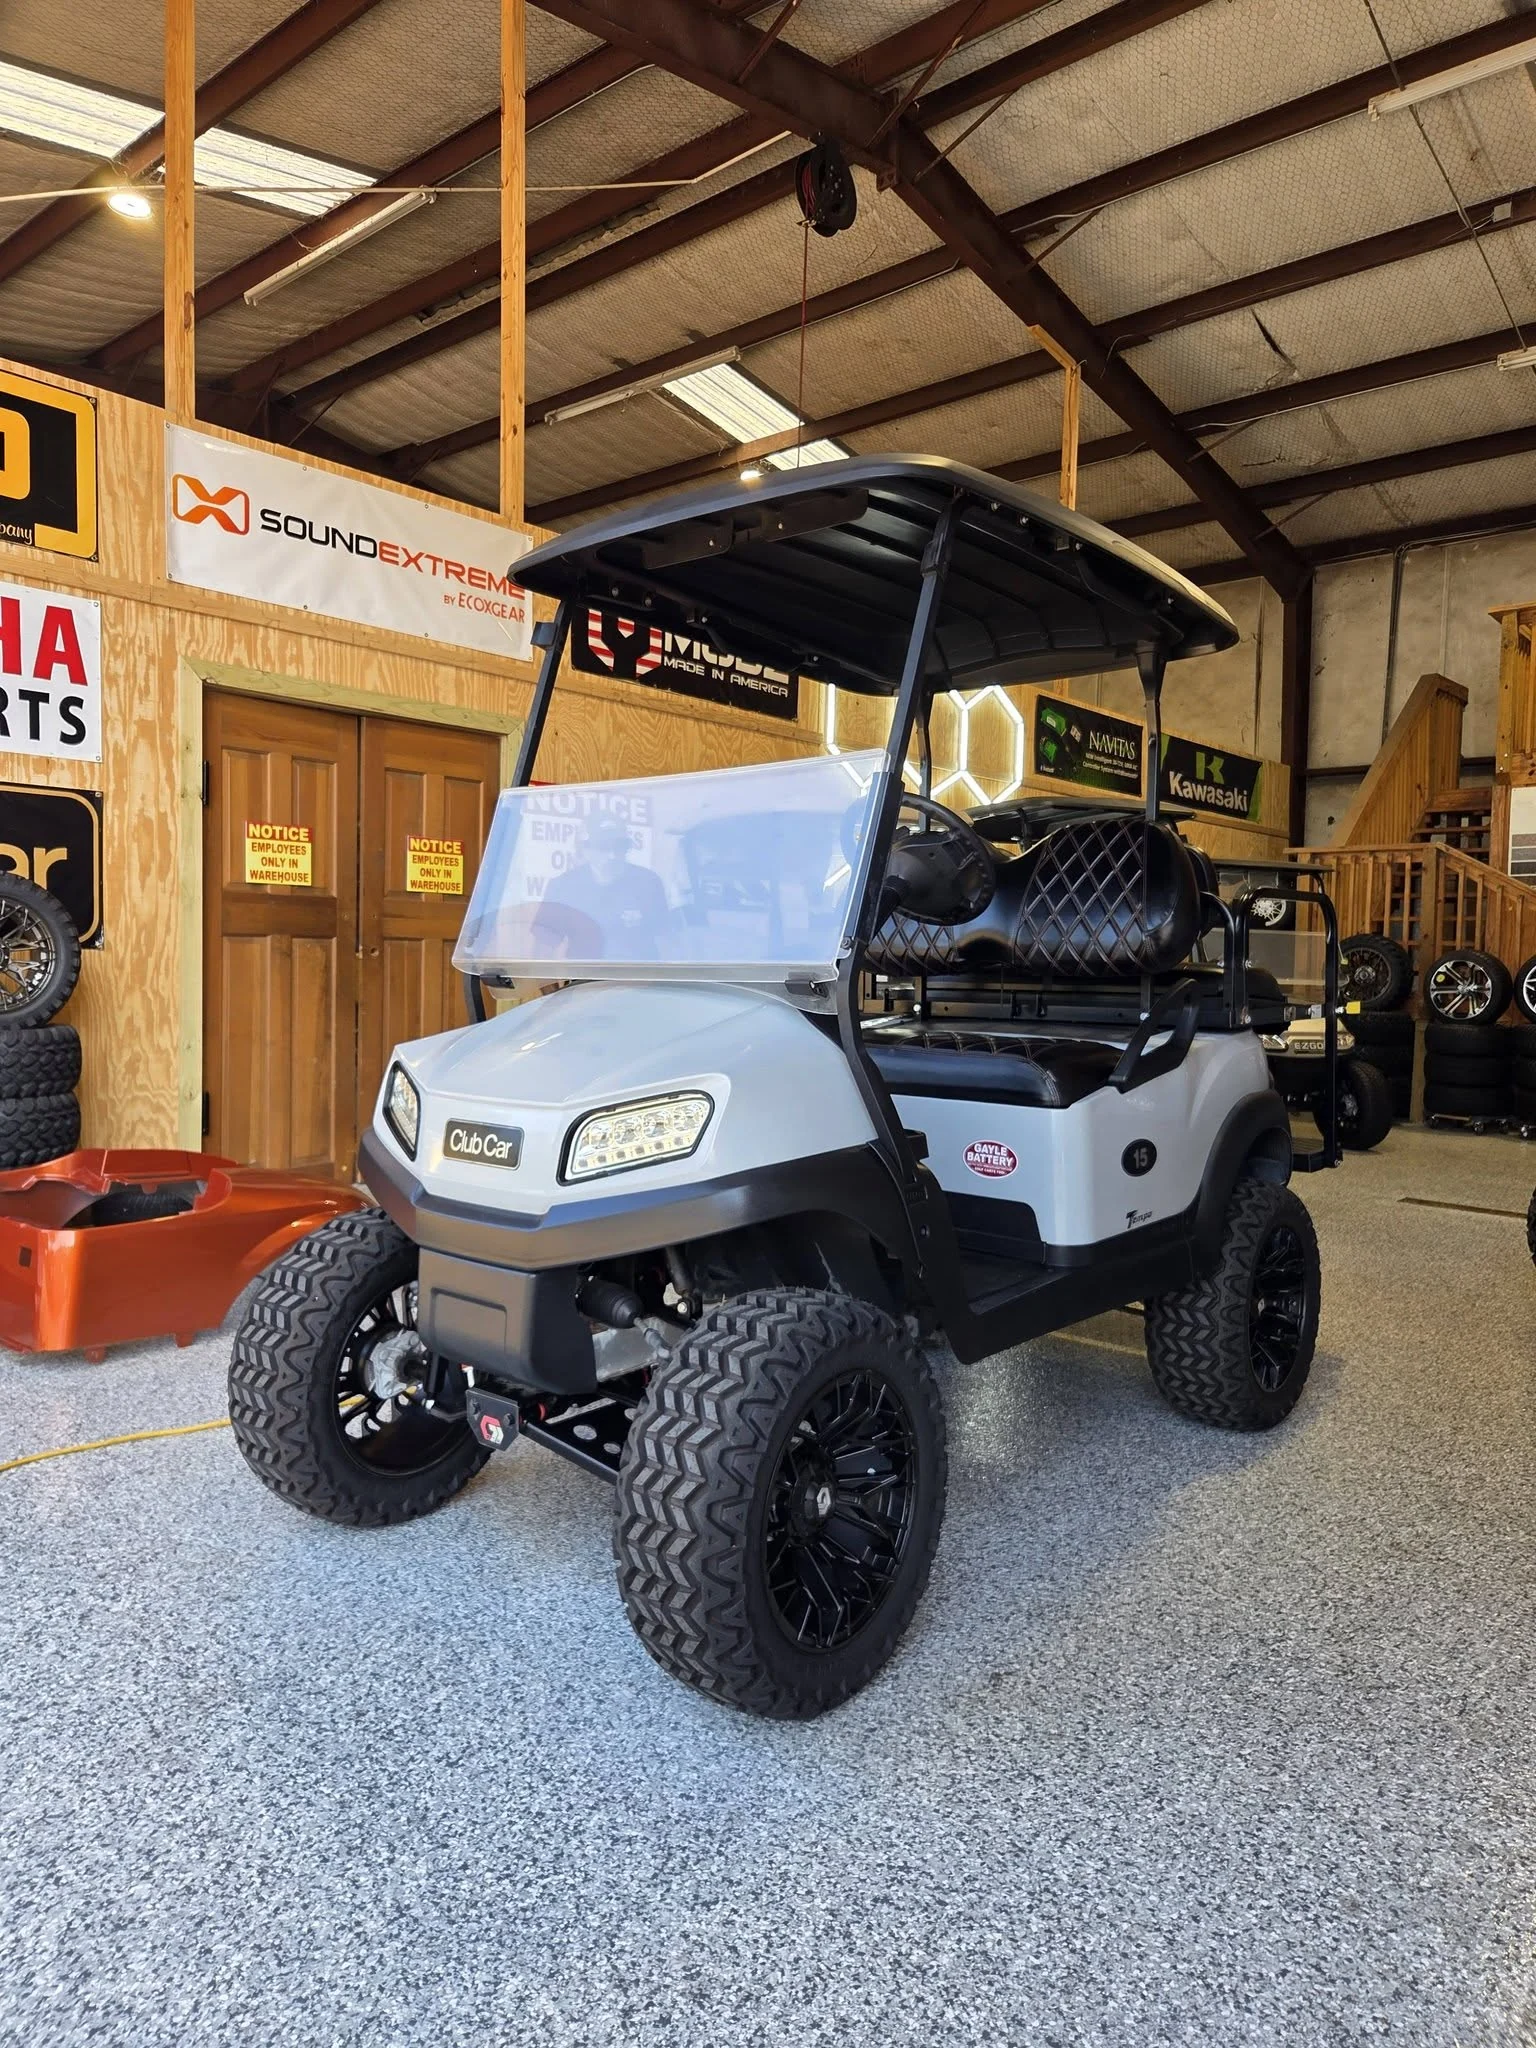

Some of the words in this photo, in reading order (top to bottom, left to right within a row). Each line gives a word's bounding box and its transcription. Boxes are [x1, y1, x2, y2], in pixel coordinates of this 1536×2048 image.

[259, 508, 526, 601] SOUNDEXTREME
[444, 594, 456, 606] BY
[458, 591, 525, 624] ECOXGEAR
[663, 655, 706, 677] MADE
[711, 668, 725, 681] IN
[729, 673, 789, 699] AMERICA
[1088, 730, 1136, 760] NAVITAS
[1169, 771, 1248, 812] Kawasaki
[248, 823, 310, 842] NOTICE
[251, 842, 307, 855] EMPLOYEES
[409, 838, 462, 854] NOTICE
[261, 856, 286, 868] ONLY
[288, 858, 299, 869] IN
[412, 854, 460, 867] EMPLOYEES
[249, 869, 310, 883] WAREHOUSE
[419, 867, 442, 878] ONLY
[443, 869, 452, 879] IN
[410, 879, 461, 892] WAREHOUSE
[449, 1128, 483, 1156] Club
[483, 1133, 513, 1160] Car
[974, 1143, 1008, 1157] GAYLE
[966, 1151, 1014, 1167] BATTERY
[1133, 1147, 1149, 1169] 15
